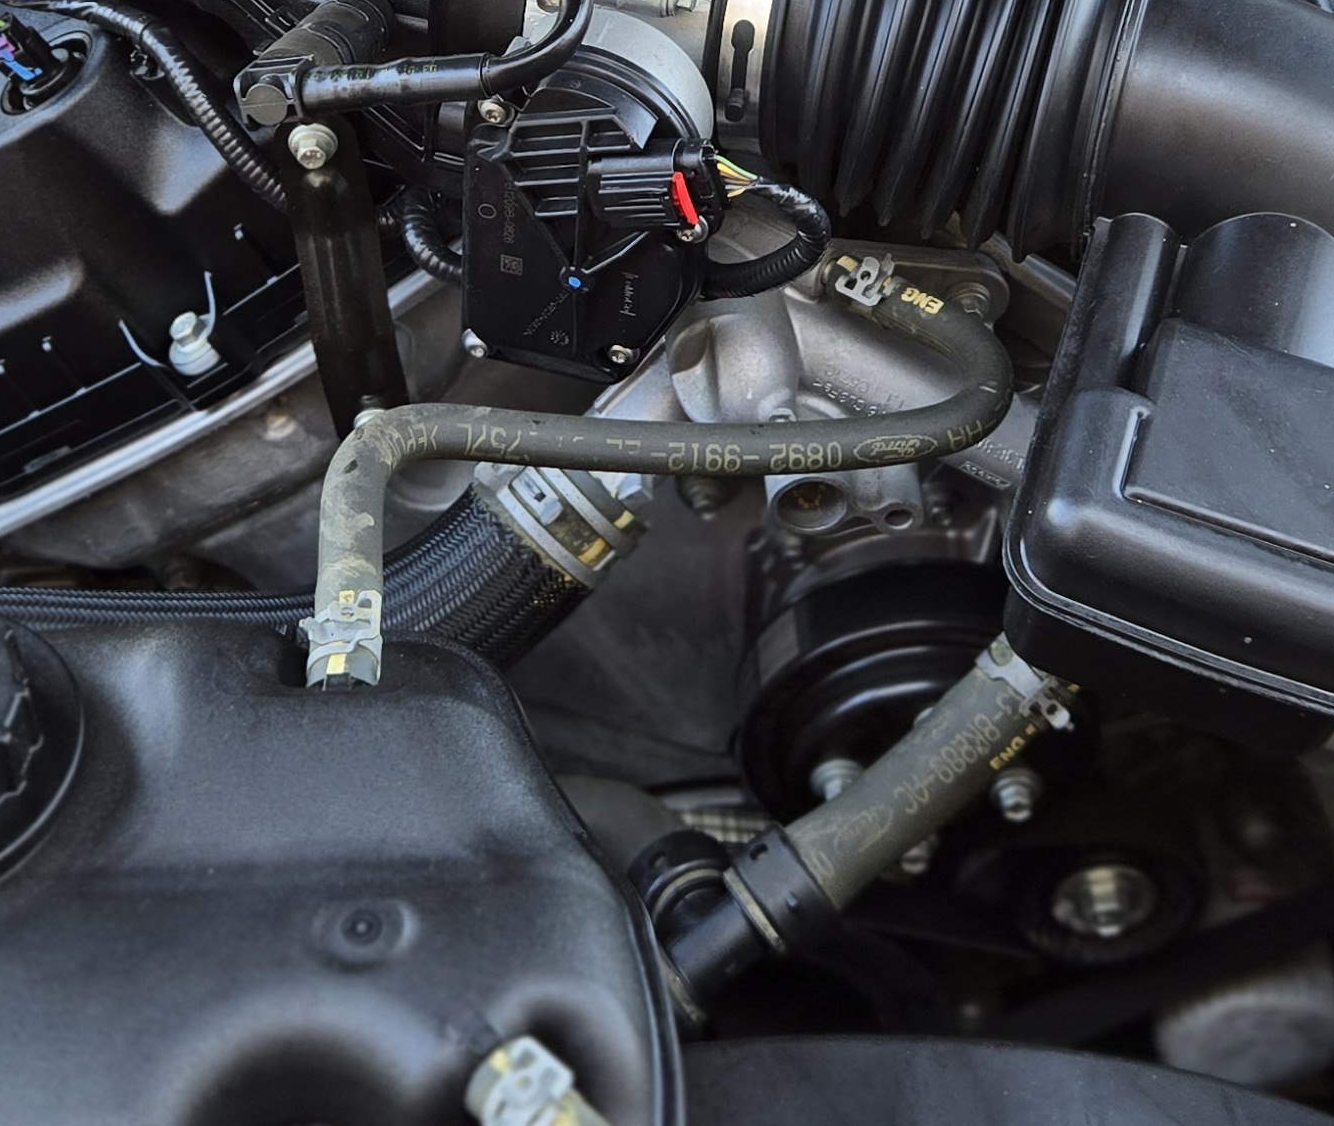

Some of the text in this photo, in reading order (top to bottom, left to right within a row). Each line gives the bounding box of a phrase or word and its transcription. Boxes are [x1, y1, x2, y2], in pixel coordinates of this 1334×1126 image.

[900, 287, 945, 315] ENG
[768, 441, 844, 472] 0892
[989, 735, 1026, 771] ENG
